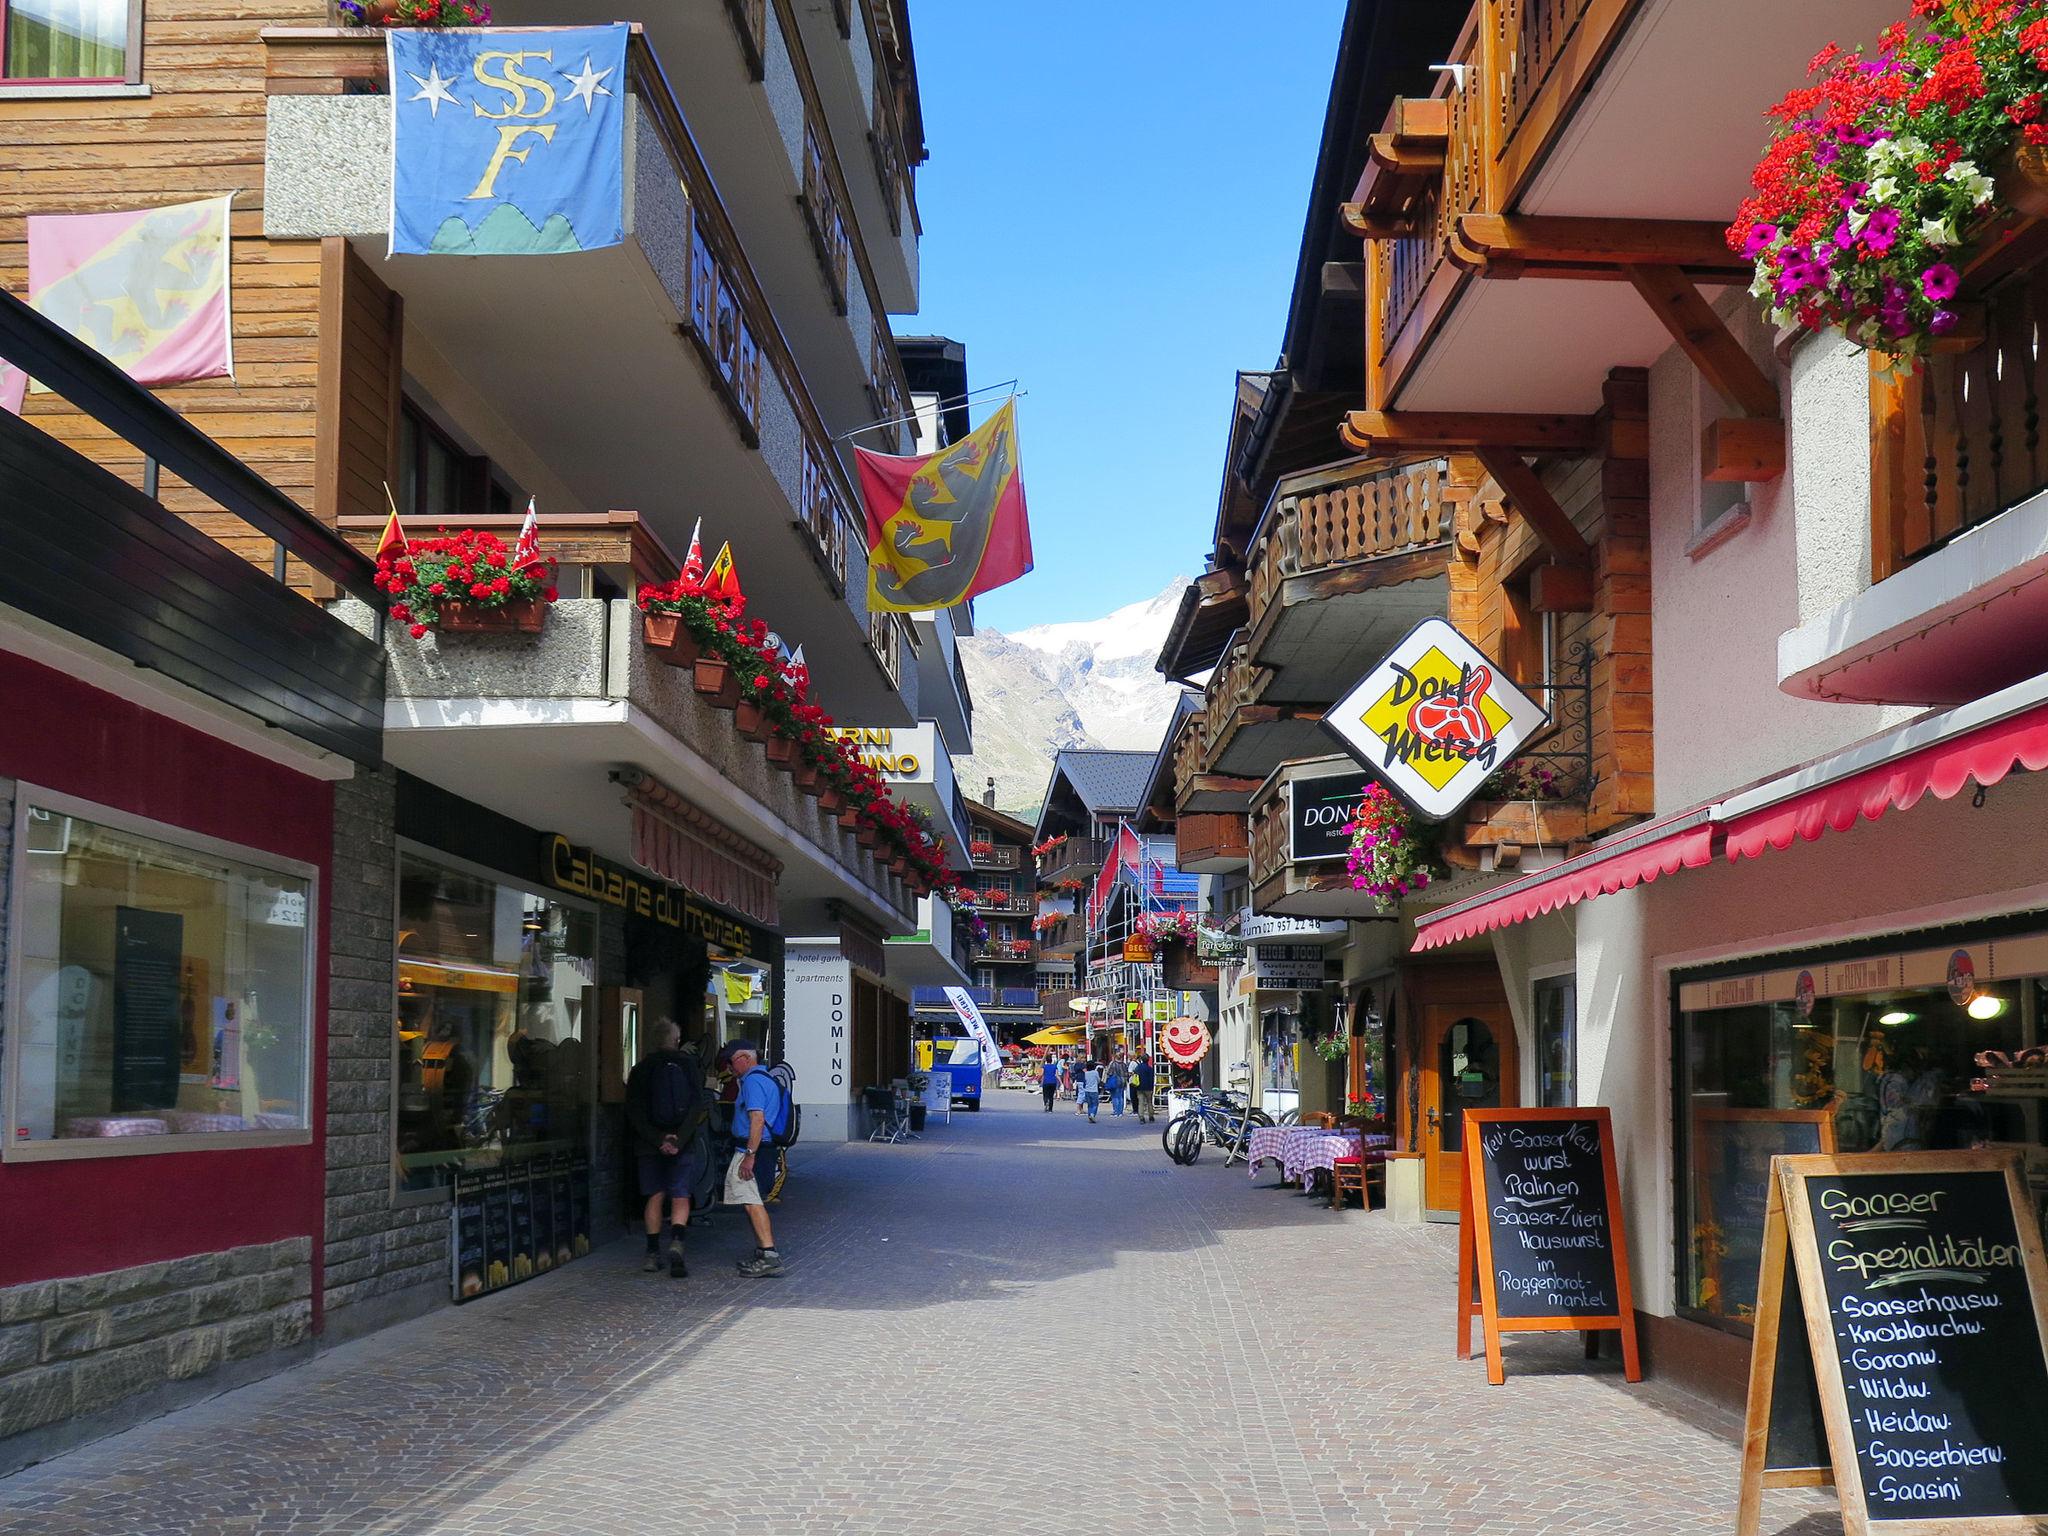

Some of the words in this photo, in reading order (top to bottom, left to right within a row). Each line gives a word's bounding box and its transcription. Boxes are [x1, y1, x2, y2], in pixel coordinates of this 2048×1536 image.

[1390, 661, 1471, 708] Dorf
[824, 727, 890, 745] ARNI
[1379, 722, 1497, 771] Metzg
[1304, 804, 1351, 827] DON
[1325, 829, 1344, 838] RISTO
[552, 834, 651, 917] Cabane
[656, 884, 681, 927] du
[1241, 924, 1262, 937] rum
[1277, 920, 1291, 932] 957
[797, 954, 820, 963] hotel
[820, 954, 843, 965] garni
[1260, 945, 1286, 960] HIGH
[1292, 945, 1322, 961] NOON
[795, 974, 844, 984] apartments
[1262, 978, 1289, 988] SPORT
[830, 994, 844, 1086] DOMINO
[1509, 1128, 1564, 1149] Saaser
[1523, 1150, 1573, 1171] wurst
[1504, 1173, 1579, 1196] Pralinen
[1820, 1189, 1948, 1220] Saaser
[1519, 1230, 1605, 1250] Hauswurst
[1535, 1256, 1555, 1272] im
[1827, 1234, 2024, 1280] Spezialitäten
